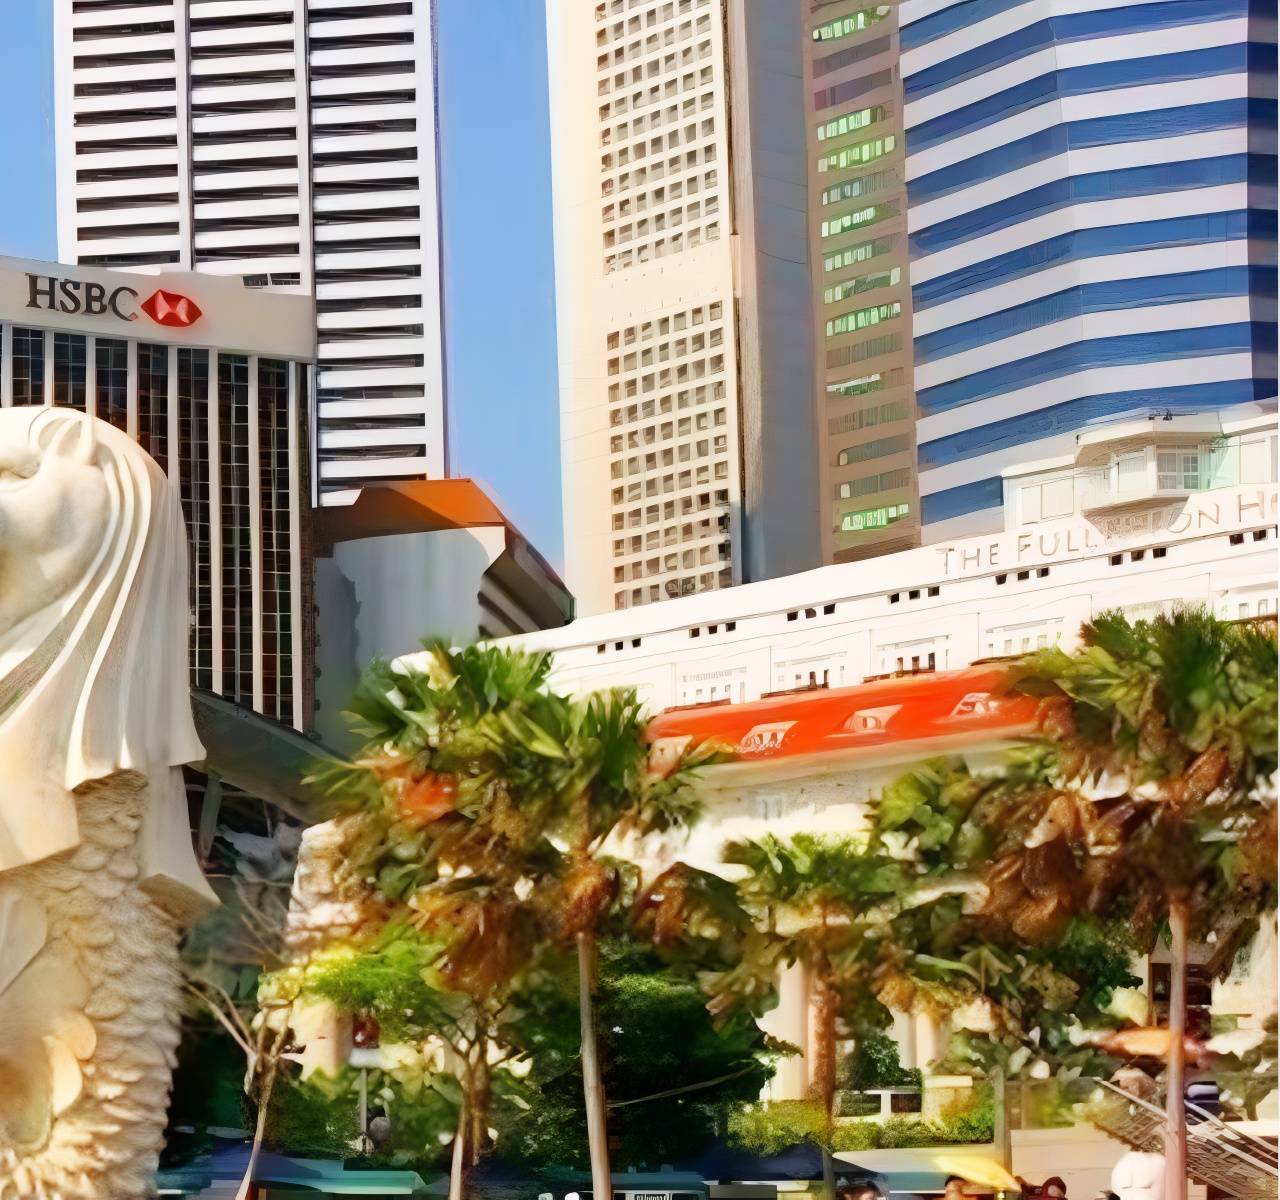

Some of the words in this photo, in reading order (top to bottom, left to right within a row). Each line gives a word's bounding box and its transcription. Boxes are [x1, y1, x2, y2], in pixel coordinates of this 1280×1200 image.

[25, 273, 139, 322] HSBC
[936, 543, 999, 574] THE
[1017, 503, 1220, 562] FULLON
